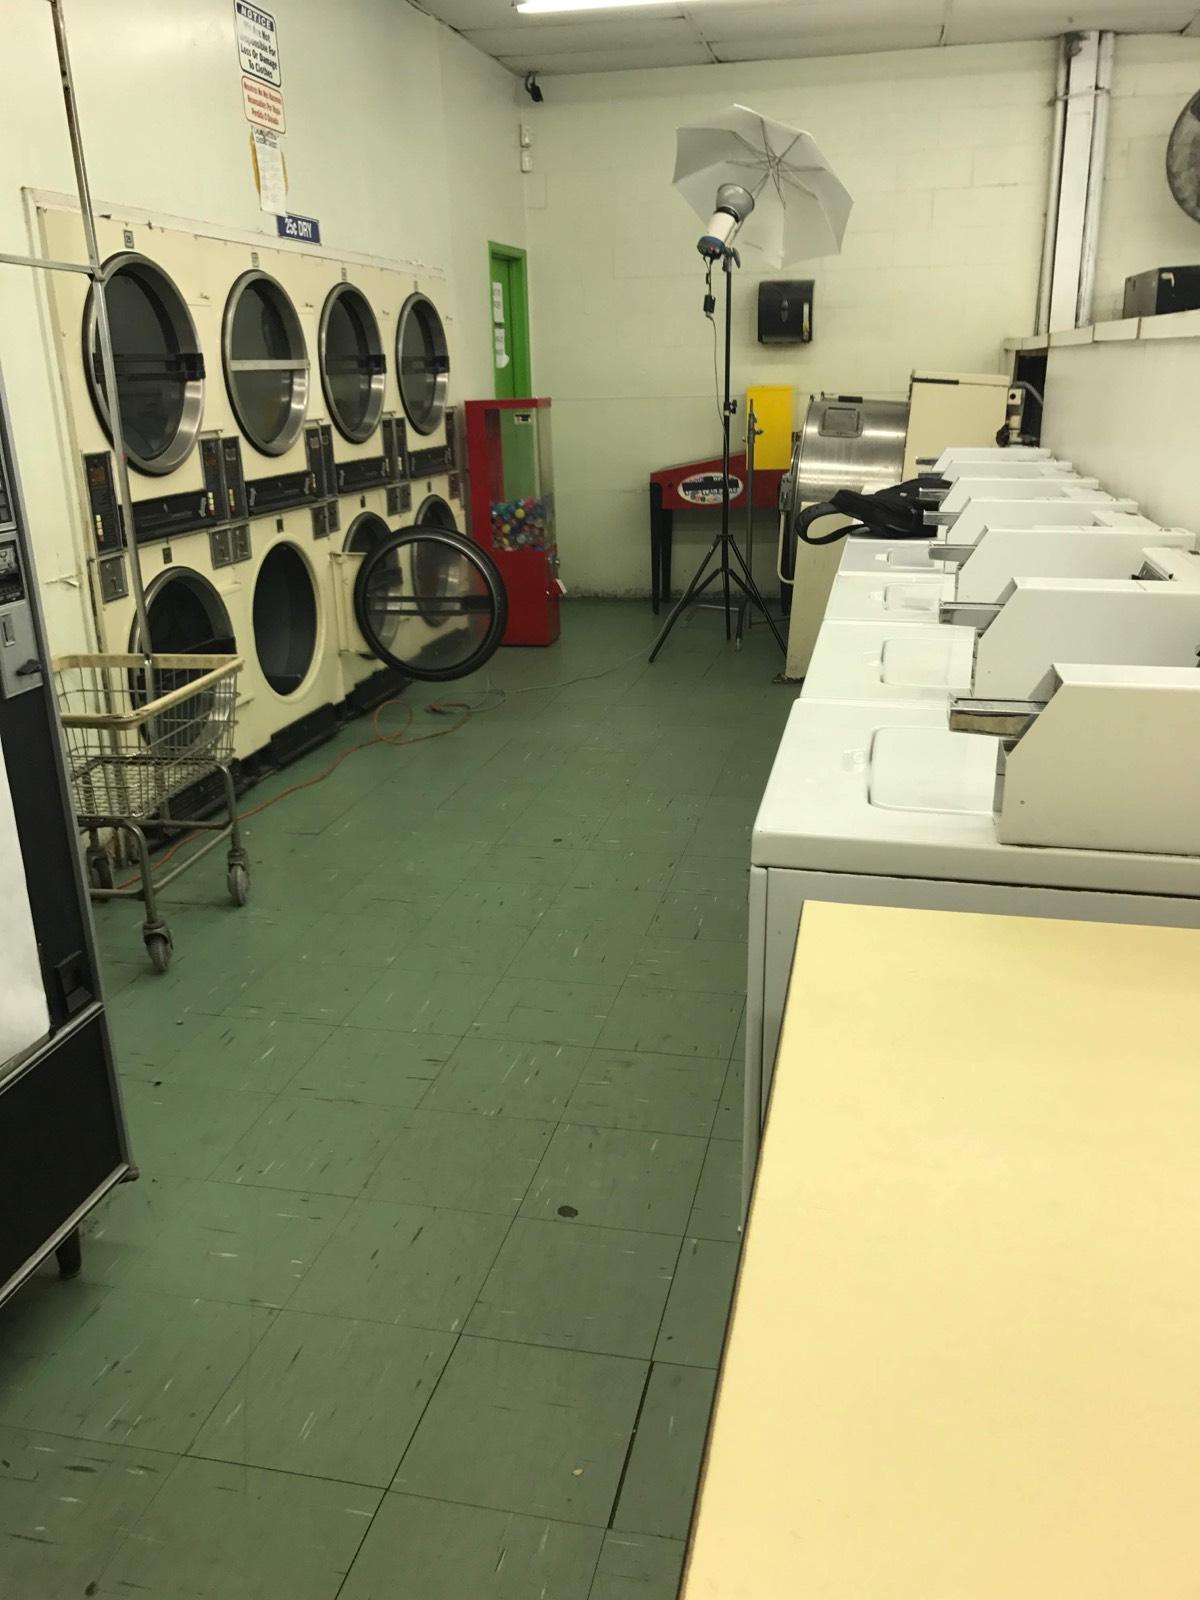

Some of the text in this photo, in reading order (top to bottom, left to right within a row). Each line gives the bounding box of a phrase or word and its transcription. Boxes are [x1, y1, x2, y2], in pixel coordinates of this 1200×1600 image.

[241, 6, 271, 29] NOTICE
[262, 30, 271, 42] Not
[241, 43, 278, 70] Loss Or Damage
[268, 45, 276, 57] For
[248, 59, 273, 79] To Clothes
[297, 220, 312, 238] DRY
